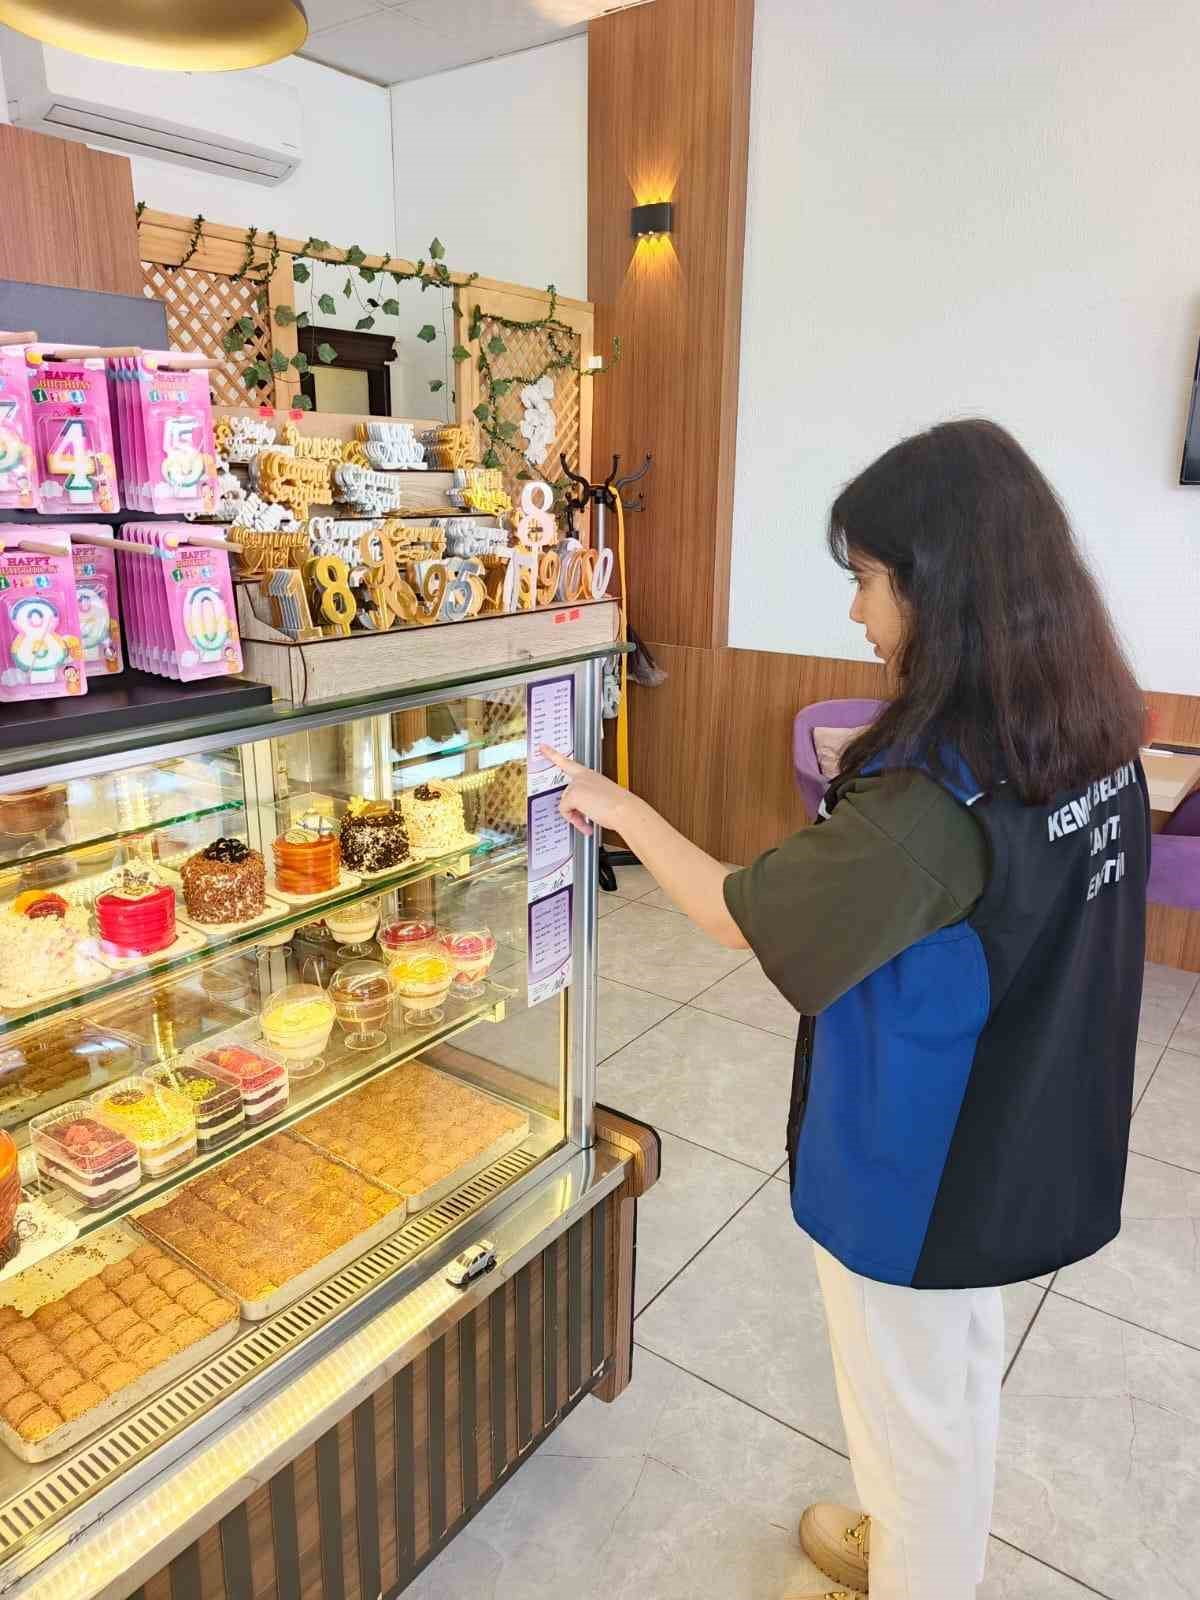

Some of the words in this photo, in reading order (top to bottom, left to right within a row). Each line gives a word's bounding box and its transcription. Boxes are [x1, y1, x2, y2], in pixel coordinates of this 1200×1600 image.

[44, 370, 84, 381] HAPPY
[47, 418, 97, 490] 4
[161, 417, 205, 488] 5
[7, 556, 50, 567] HAPPY
[314, 556, 357, 634] 8
[10, 596, 67, 672] 8
[183, 586, 229, 652] 0
